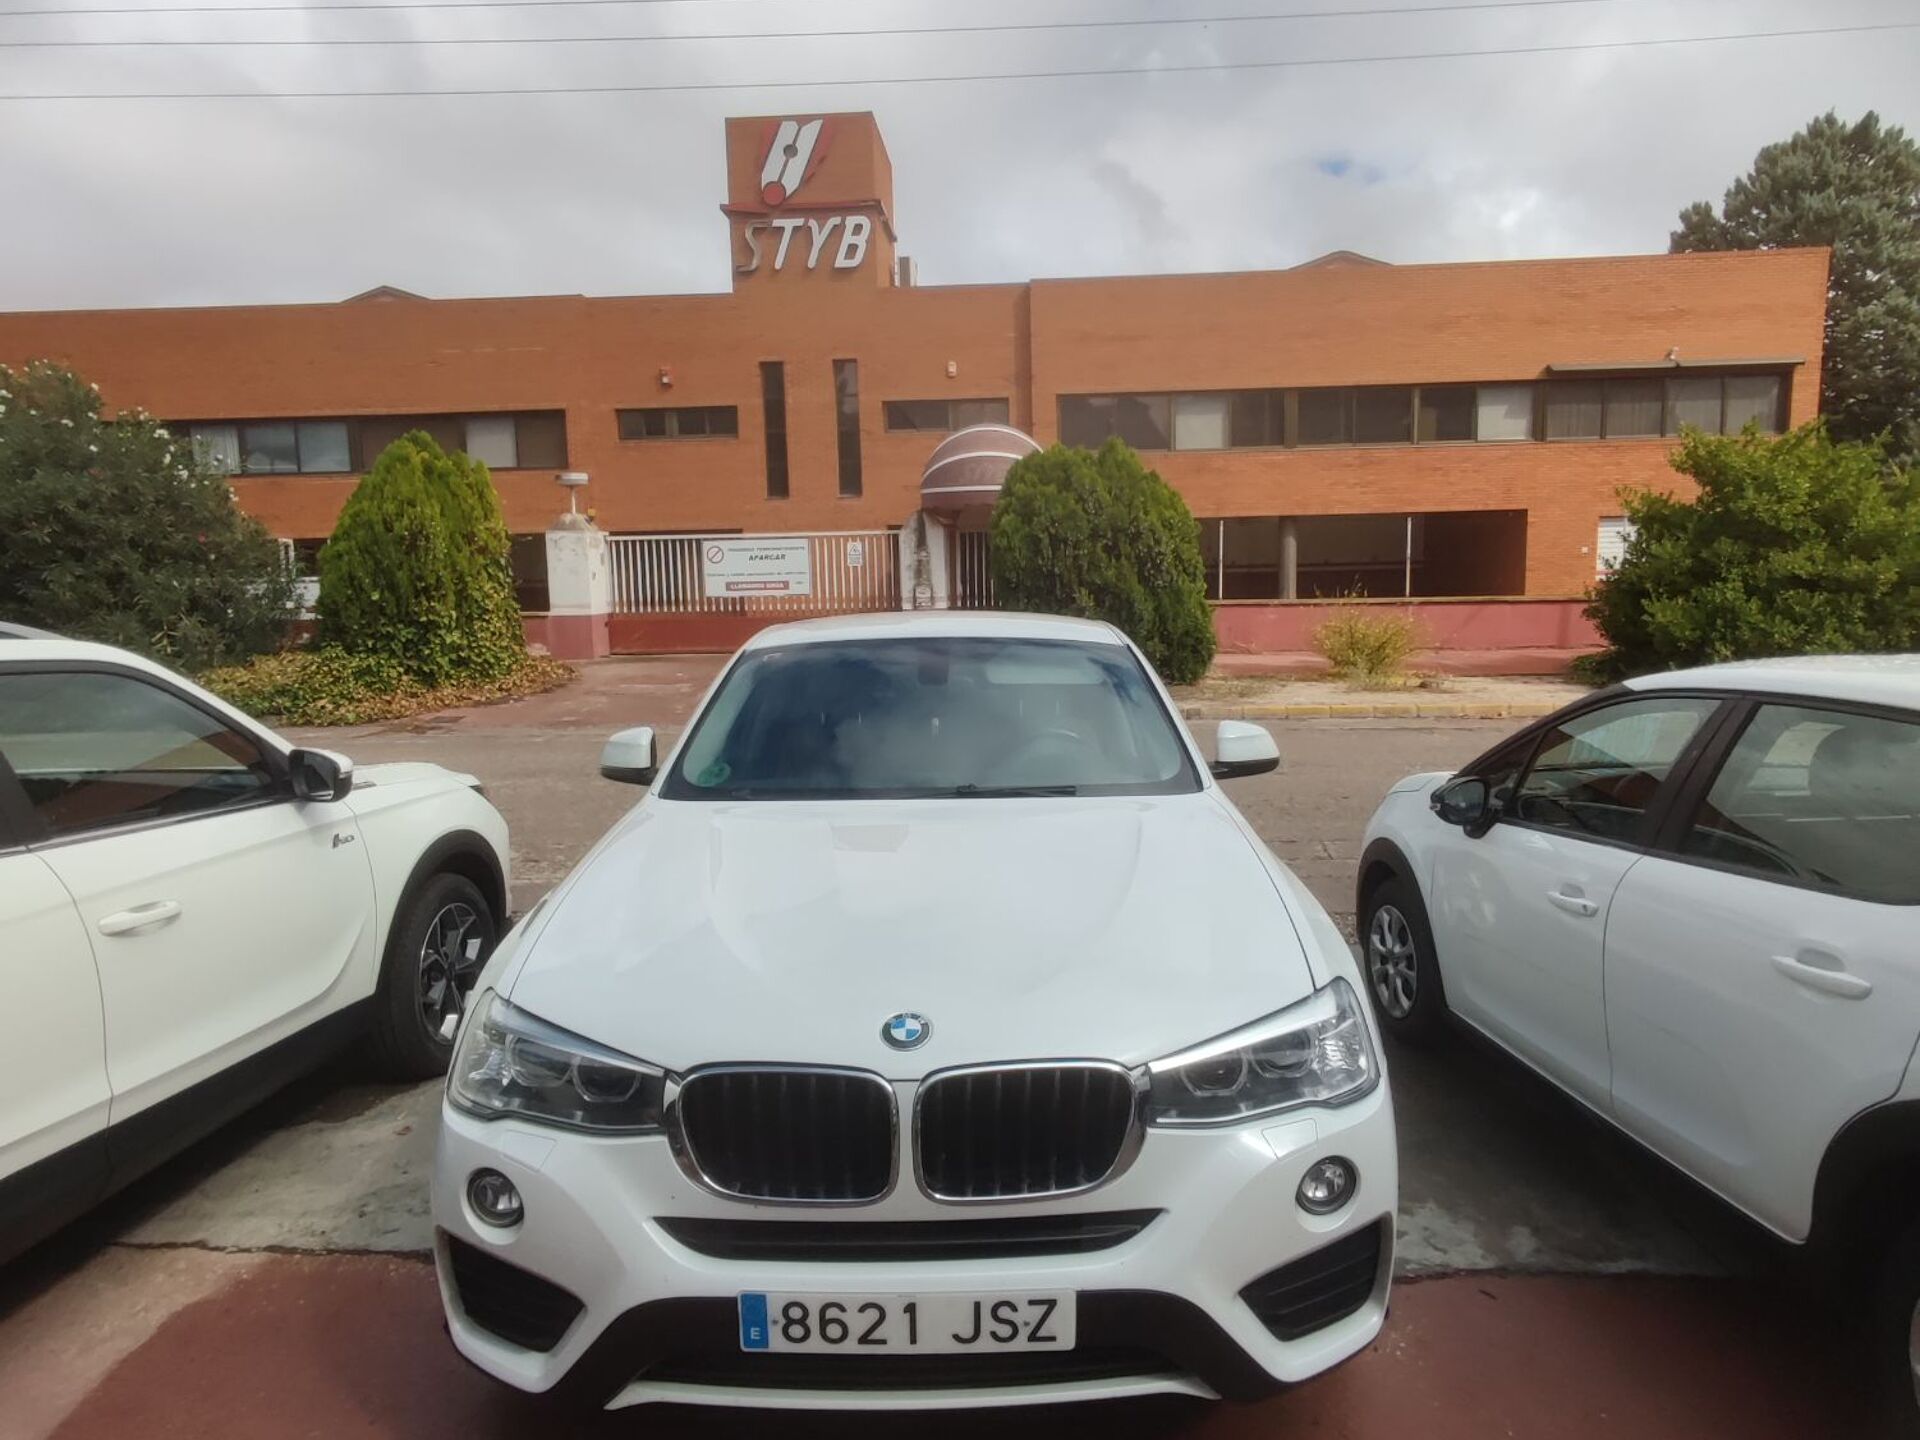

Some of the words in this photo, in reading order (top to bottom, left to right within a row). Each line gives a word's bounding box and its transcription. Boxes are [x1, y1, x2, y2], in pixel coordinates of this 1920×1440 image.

[736, 215, 871, 273] STYB
[750, 1327, 761, 1340] E
[781, 1301, 918, 1345] 8621
[951, 1298, 1058, 1344] JSZ
